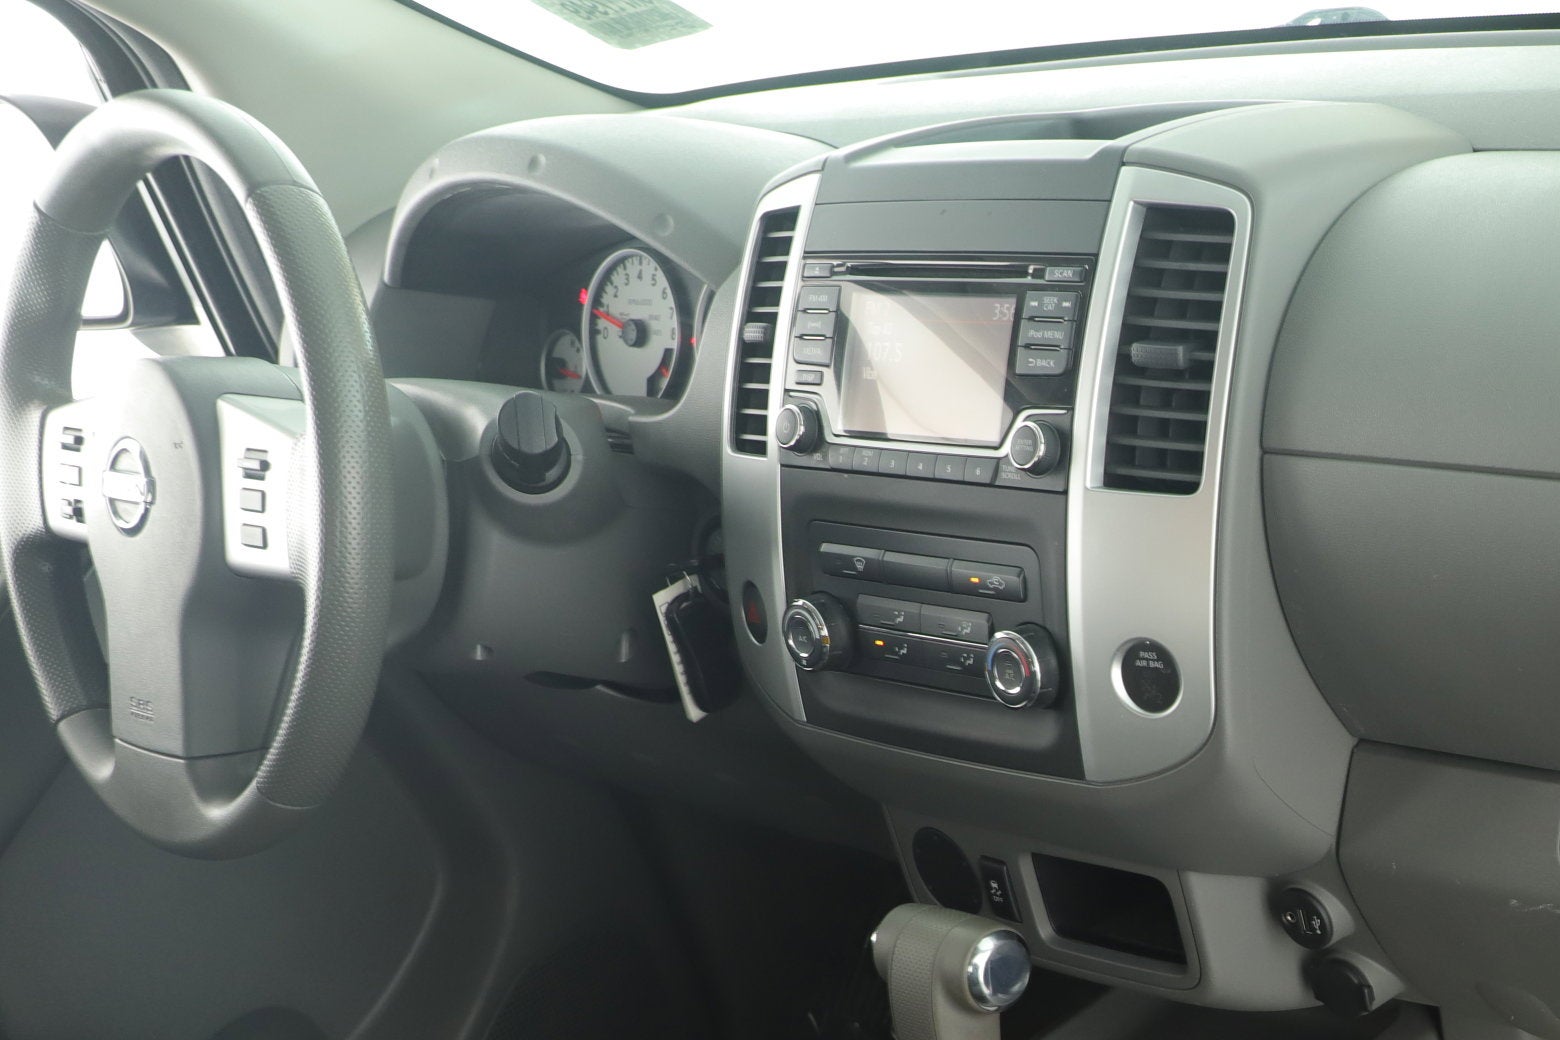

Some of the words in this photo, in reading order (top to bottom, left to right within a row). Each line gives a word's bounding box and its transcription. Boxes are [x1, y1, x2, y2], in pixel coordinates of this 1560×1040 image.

[1054, 270, 1073, 278] SCAN
[1044, 331, 1064, 339] MENU
[1036, 359, 1055, 367] BACK
